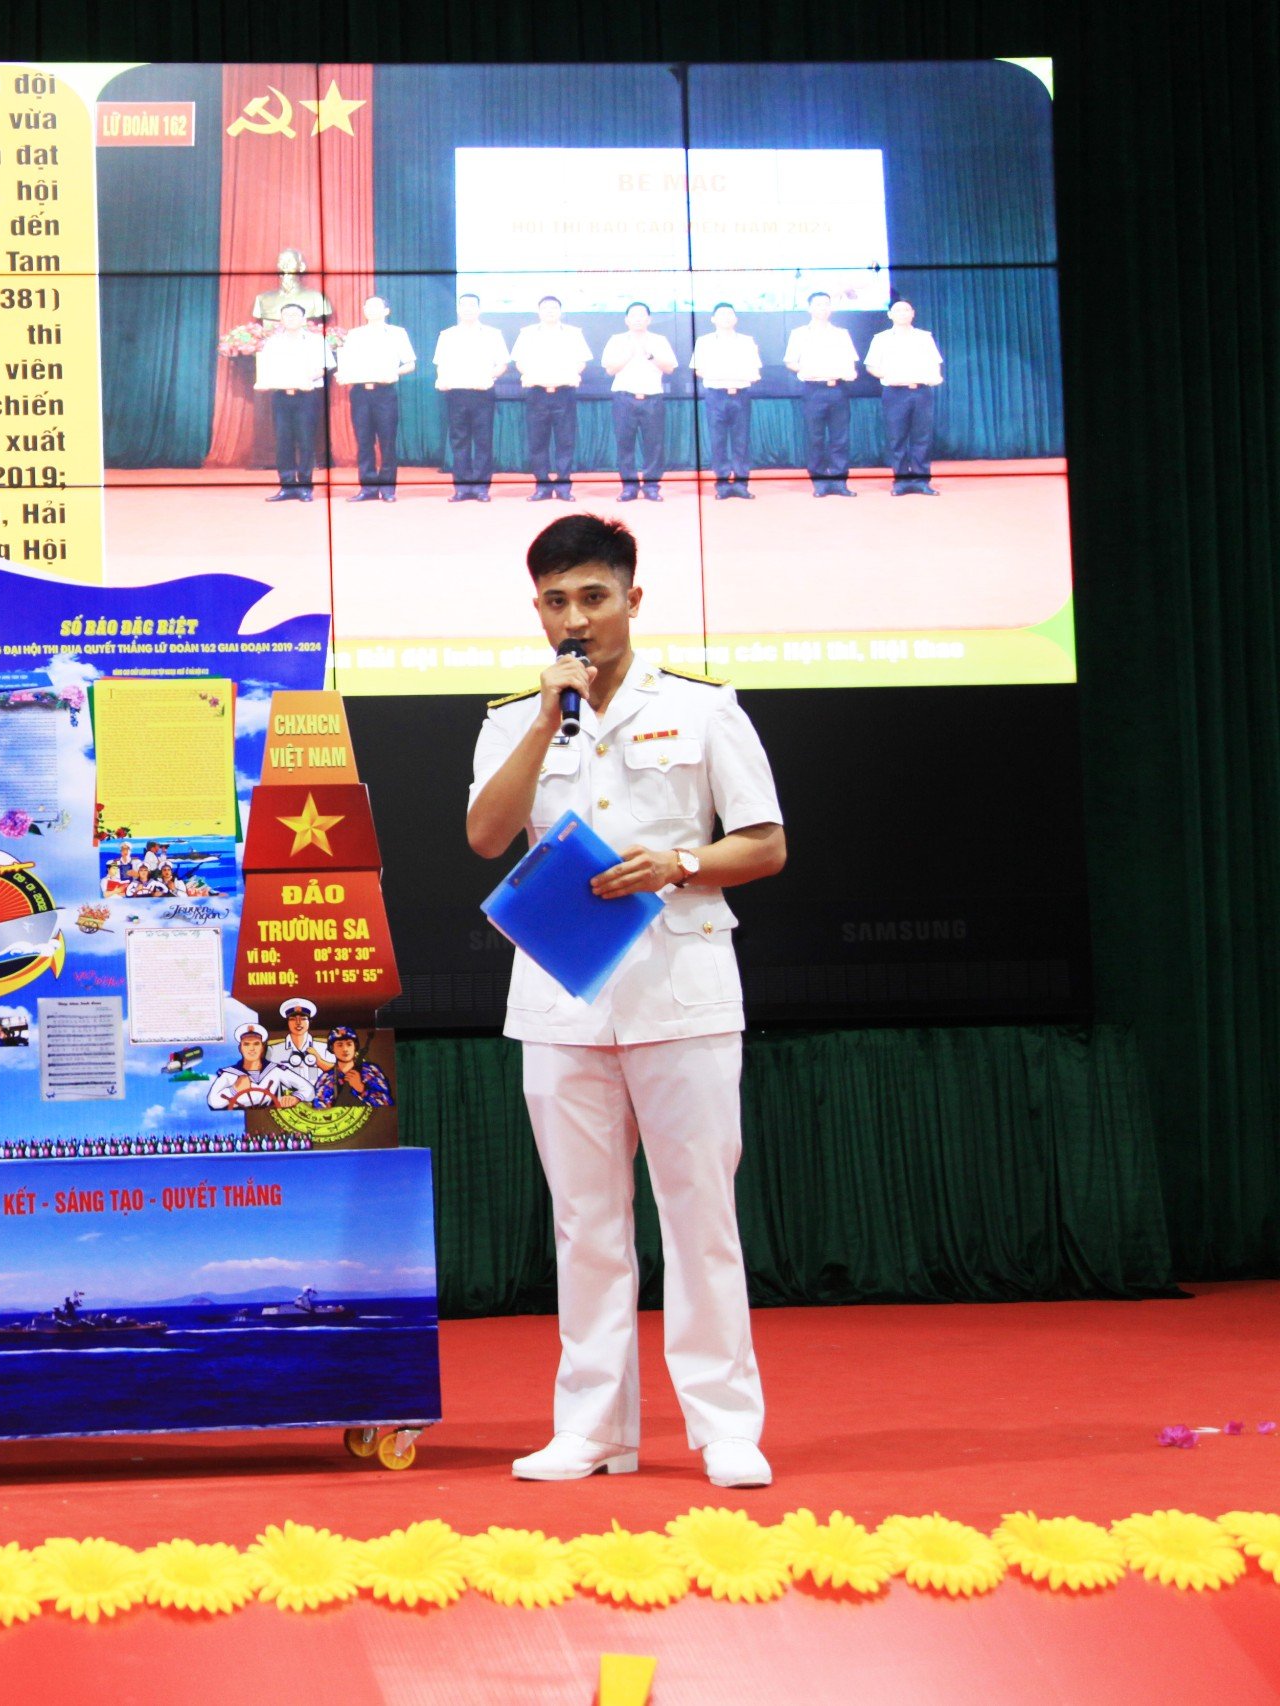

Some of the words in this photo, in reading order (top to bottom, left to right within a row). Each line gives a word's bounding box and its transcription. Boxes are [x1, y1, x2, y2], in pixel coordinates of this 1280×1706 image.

[15, 74, 55, 98] đội
[9, 109, 57, 130] vừa
[163, 115, 187, 136] 162
[16, 145, 58, 170] đạt
[17, 181, 58, 204] hội
[10, 211, 59, 237] đến
[6, 252, 60, 272] Tam
[0, 289, 60, 312] 381)
[28, 324, 61, 345] thi
[6, 361, 62, 381] viên
[6, 426, 65, 452] xuất
[22, 501, 65, 524] Hải
[23, 540, 66, 562] Hội
[60, 614, 83, 636] SỐ
[84, 616, 118, 636] BÁO
[120, 616, 154, 639] ĐẶC
[3, 645, 21, 657] ĐẠI
[23, 642, 41, 657] HỘI
[43, 645, 58, 654] THI
[84, 641, 115, 654] QUYẾT
[170, 641, 199, 654] ĐOÀN
[202, 643, 216, 653] 162
[218, 642, 239, 652] GIAI
[272, 642, 292, 652] 2019
[274, 714, 340, 736] CHXHCN
[270, 744, 304, 772] VIỆT
[308, 746, 346, 768] NAM
[281, 878, 345, 904] ĐẢO
[258, 914, 337, 942] TRƯỜNG
[343, 918, 370, 940] SA
[841, 920, 966, 942] SAMSUNG
[248, 972, 276, 986] KINH
[4, 1186, 36, 1215] KẾT
[55, 1186, 104, 1214] SÁNG
[110, 1188, 144, 1216] TẠO
[162, 1178, 216, 1212] QUYẾT
[222, 1177, 282, 1207] THẮNG
